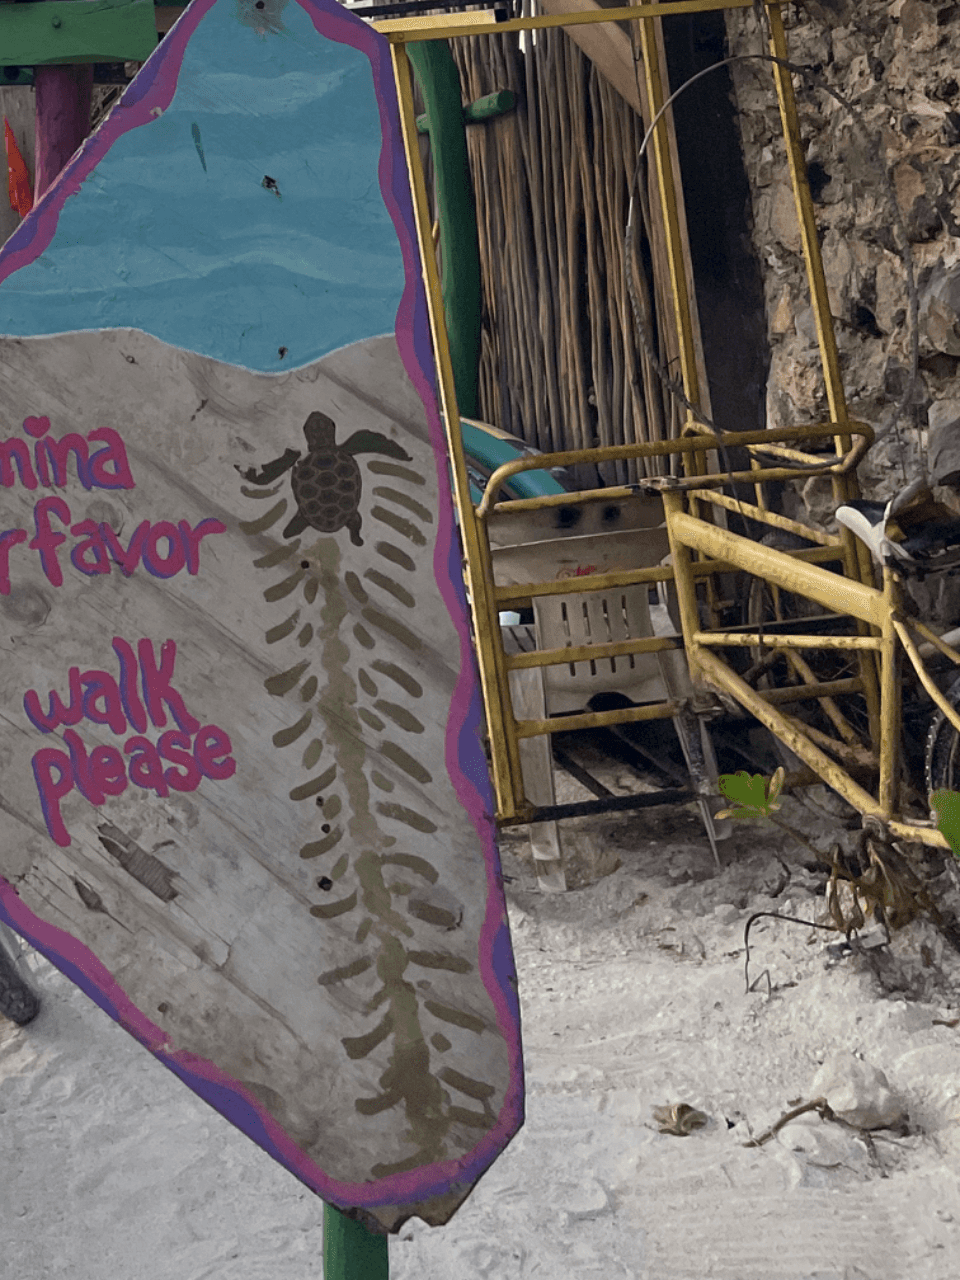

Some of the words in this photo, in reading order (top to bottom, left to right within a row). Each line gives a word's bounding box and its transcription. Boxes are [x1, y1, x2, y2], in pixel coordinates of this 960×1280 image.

[28, 496, 227, 587] favor
[23, 636, 201, 735] walk
[31, 724, 237, 847] please
